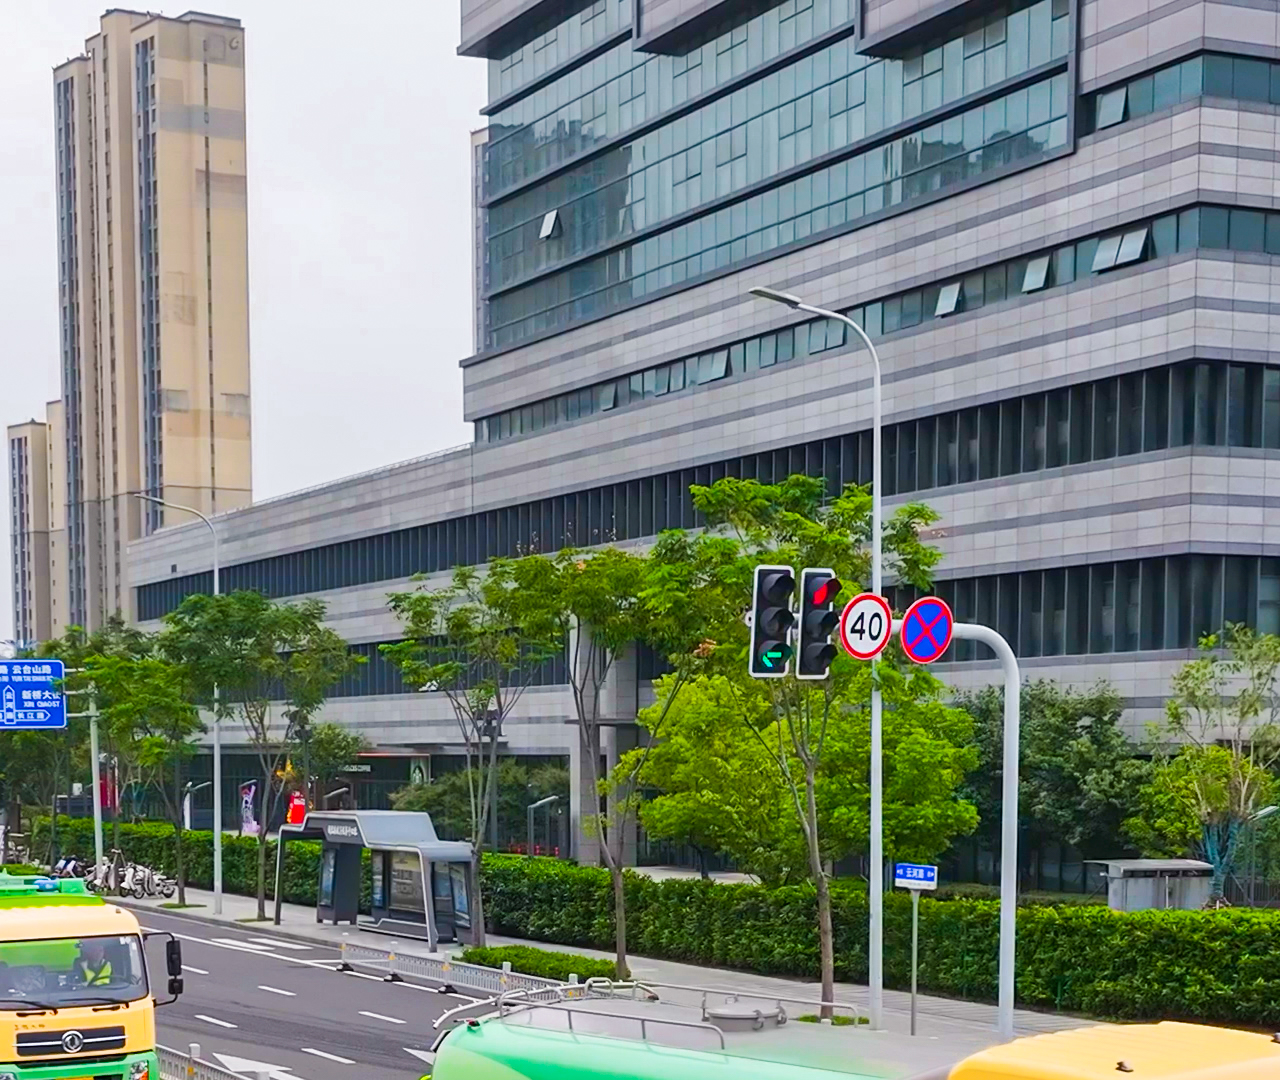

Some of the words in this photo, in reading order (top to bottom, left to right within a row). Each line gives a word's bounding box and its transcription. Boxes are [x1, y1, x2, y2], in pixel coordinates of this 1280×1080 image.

[850, 611, 883, 641] 40
[11, 664, 52, 675] 云台山路
[17, 711, 45, 720] 长江路
